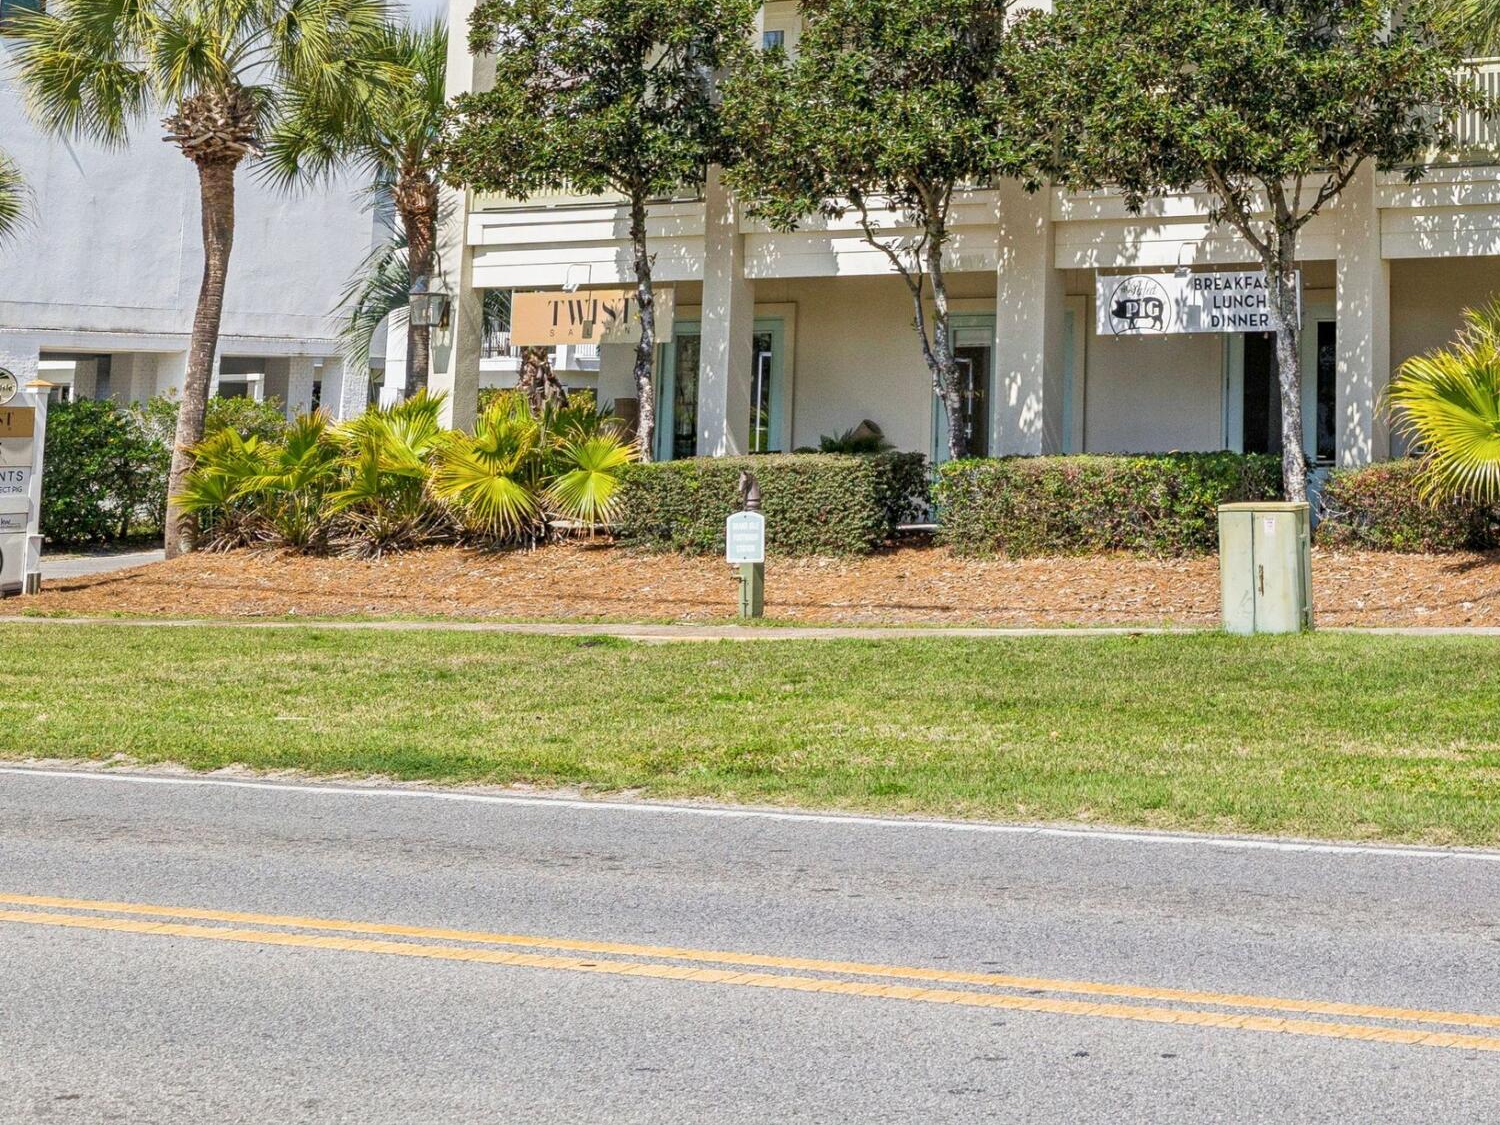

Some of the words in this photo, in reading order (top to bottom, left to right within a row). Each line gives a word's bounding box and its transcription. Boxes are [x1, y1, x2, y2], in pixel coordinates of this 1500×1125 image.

[1125, 301, 1160, 317] PIG
[1213, 295, 1267, 309] LUNCH
[547, 298, 635, 326] TWIST
[1211, 314, 1270, 327] DINNER
